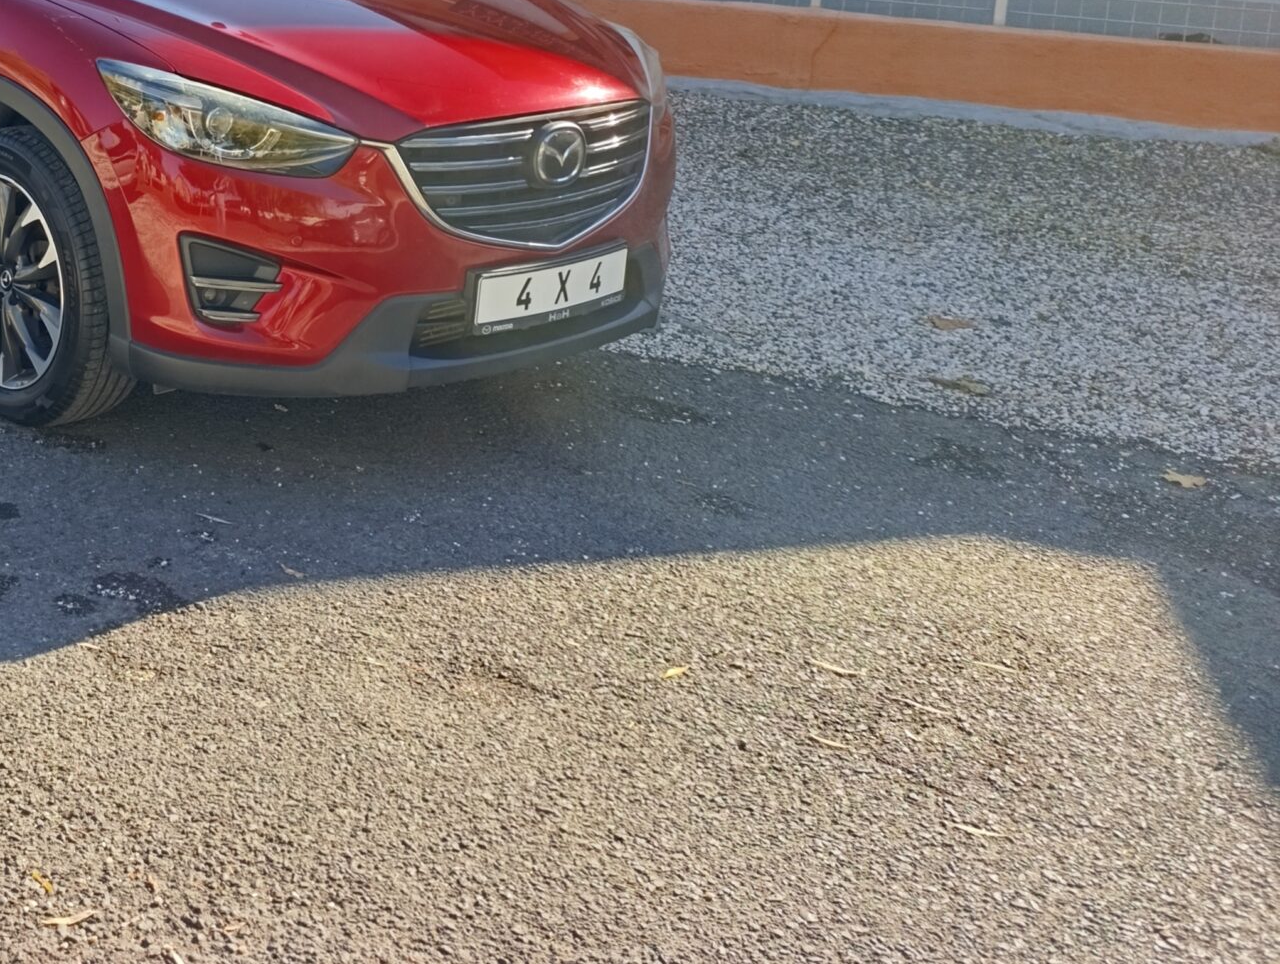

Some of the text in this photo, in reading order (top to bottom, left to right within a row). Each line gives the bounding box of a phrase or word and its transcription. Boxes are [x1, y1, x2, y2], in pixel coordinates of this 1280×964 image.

[516, 261, 602, 310] 4 X 4
